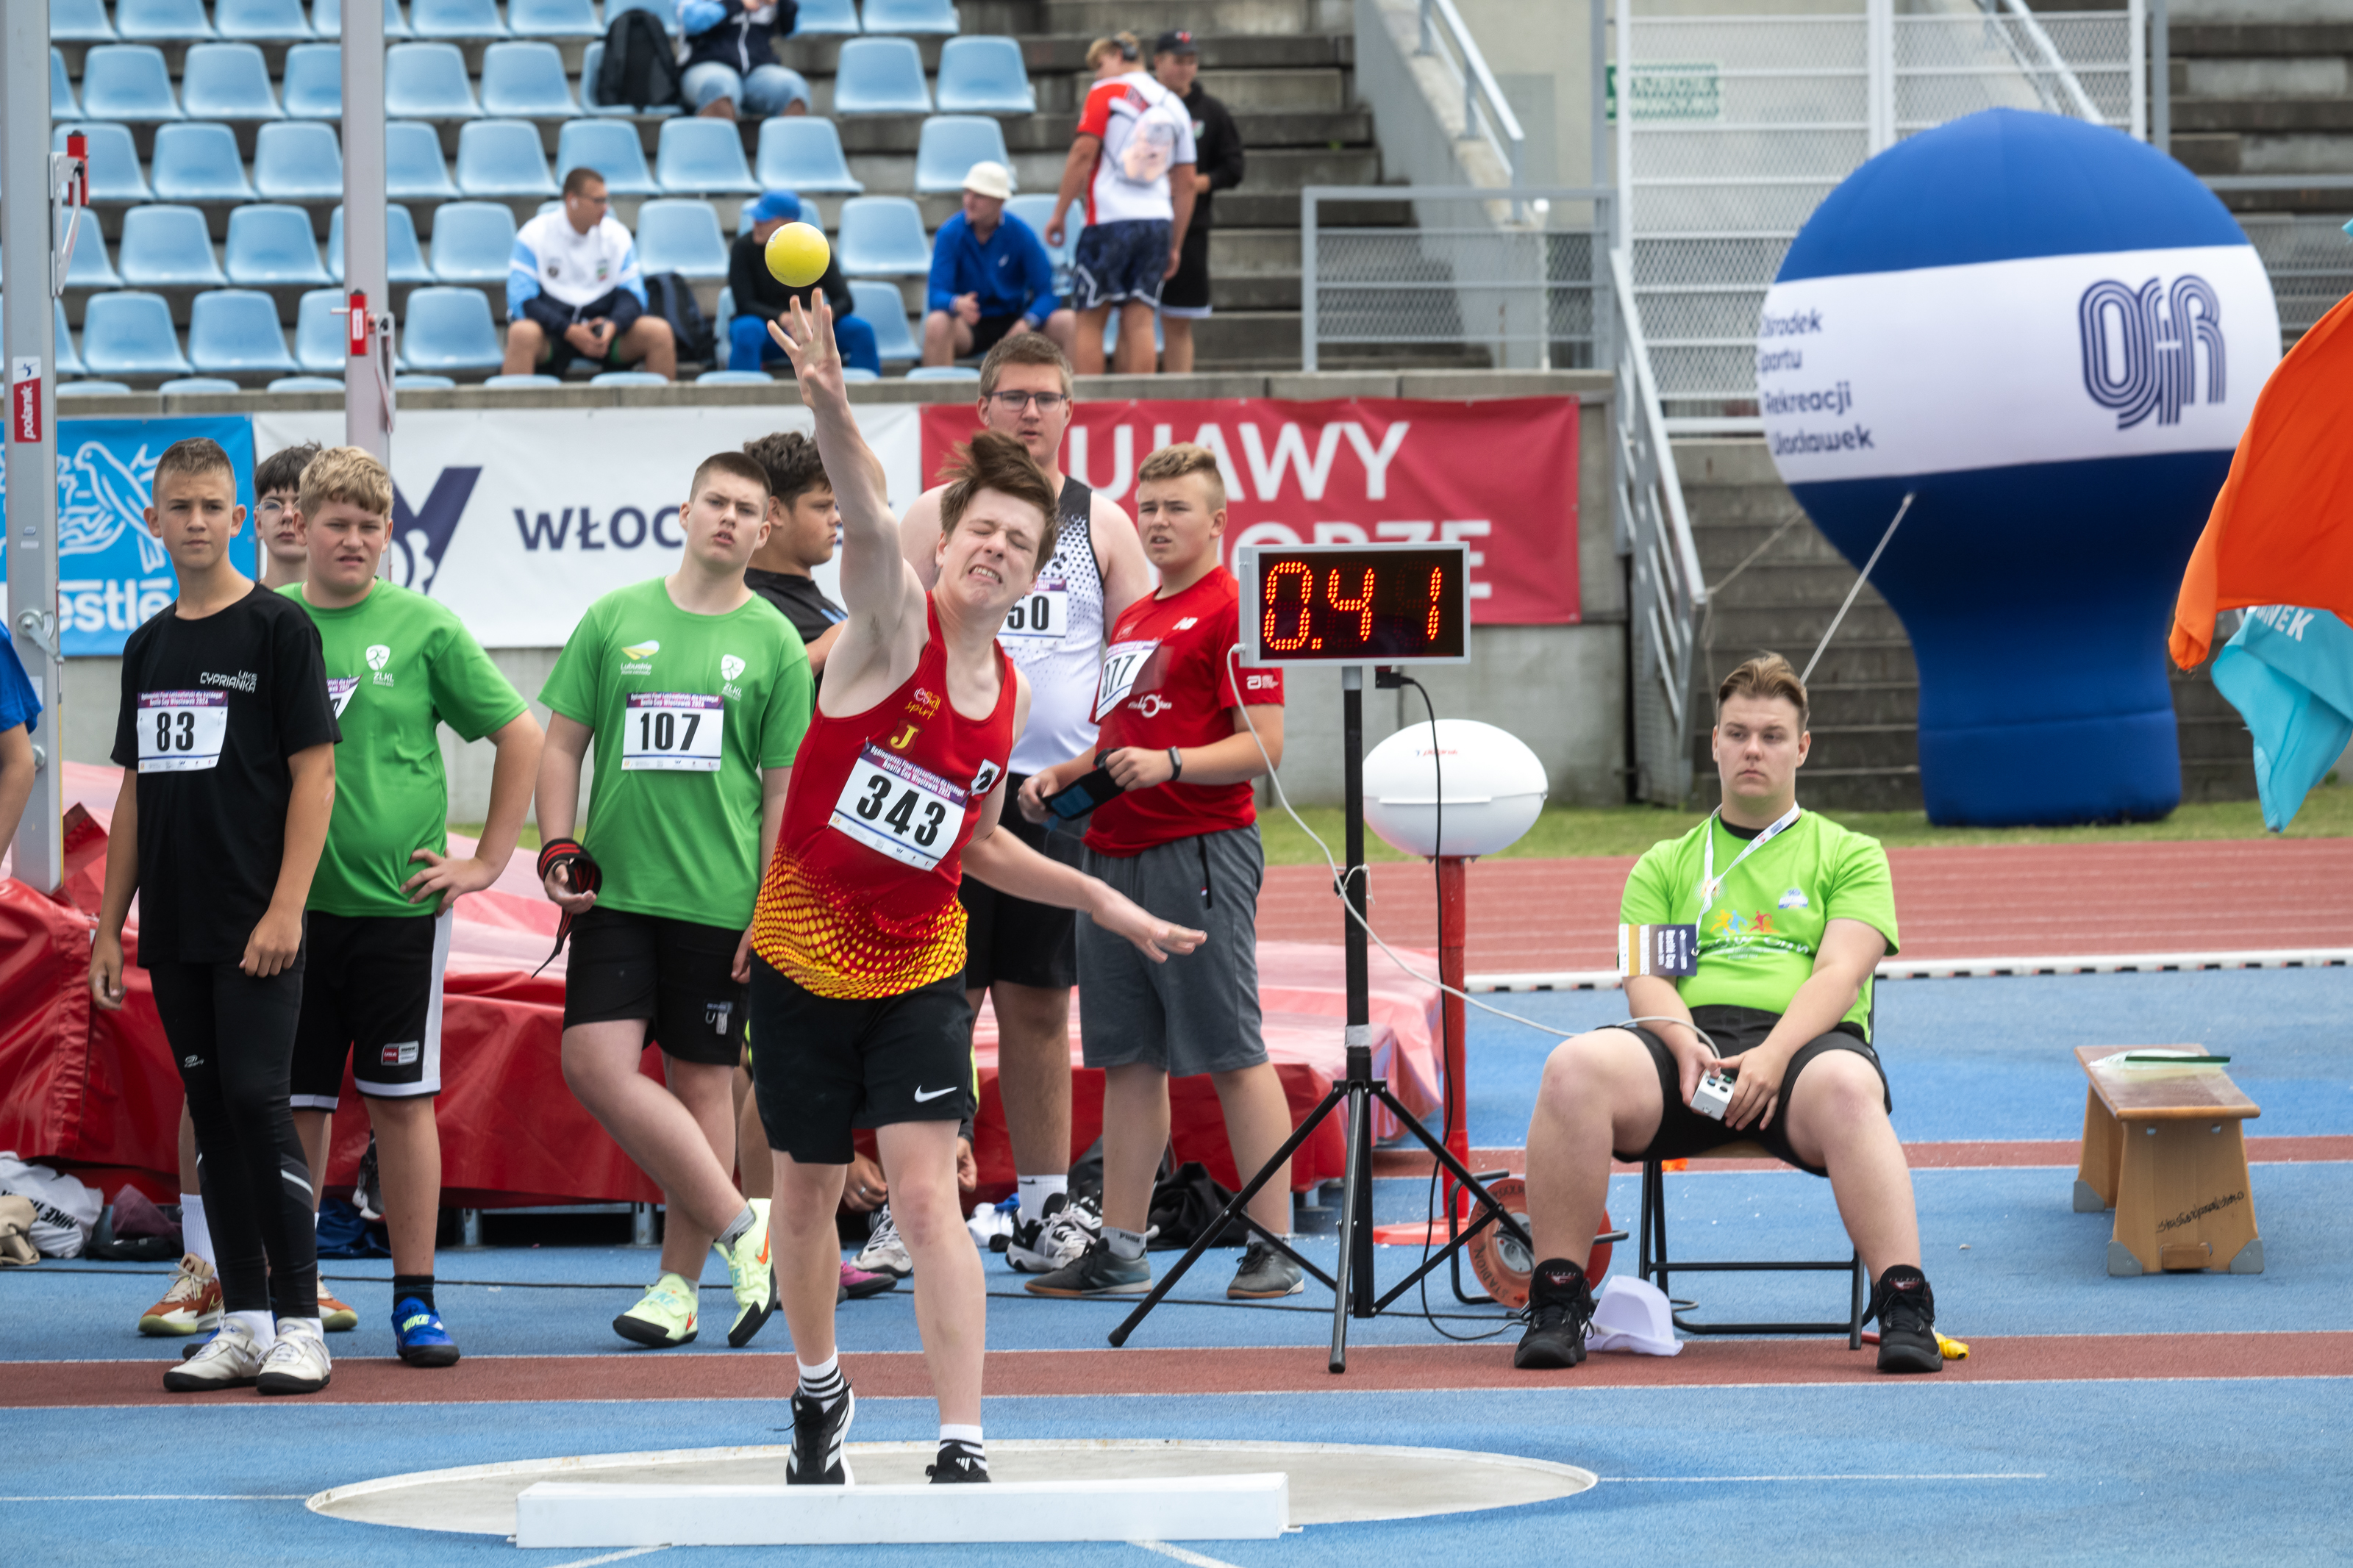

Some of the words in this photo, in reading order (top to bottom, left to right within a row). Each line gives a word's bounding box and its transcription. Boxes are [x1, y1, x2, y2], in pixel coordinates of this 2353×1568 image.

[57, 576, 173, 632] estlé
[200, 671, 257, 693] CYPRIANKA
[1102, 654, 1138, 700] 377
[156, 712, 195, 752] 83
[640, 712, 701, 752] 107
[890, 724, 919, 750] J
[856, 775, 946, 847] 343
[40, 1206, 79, 1231] NIKE
[402, 1314, 430, 1333] NIKE
